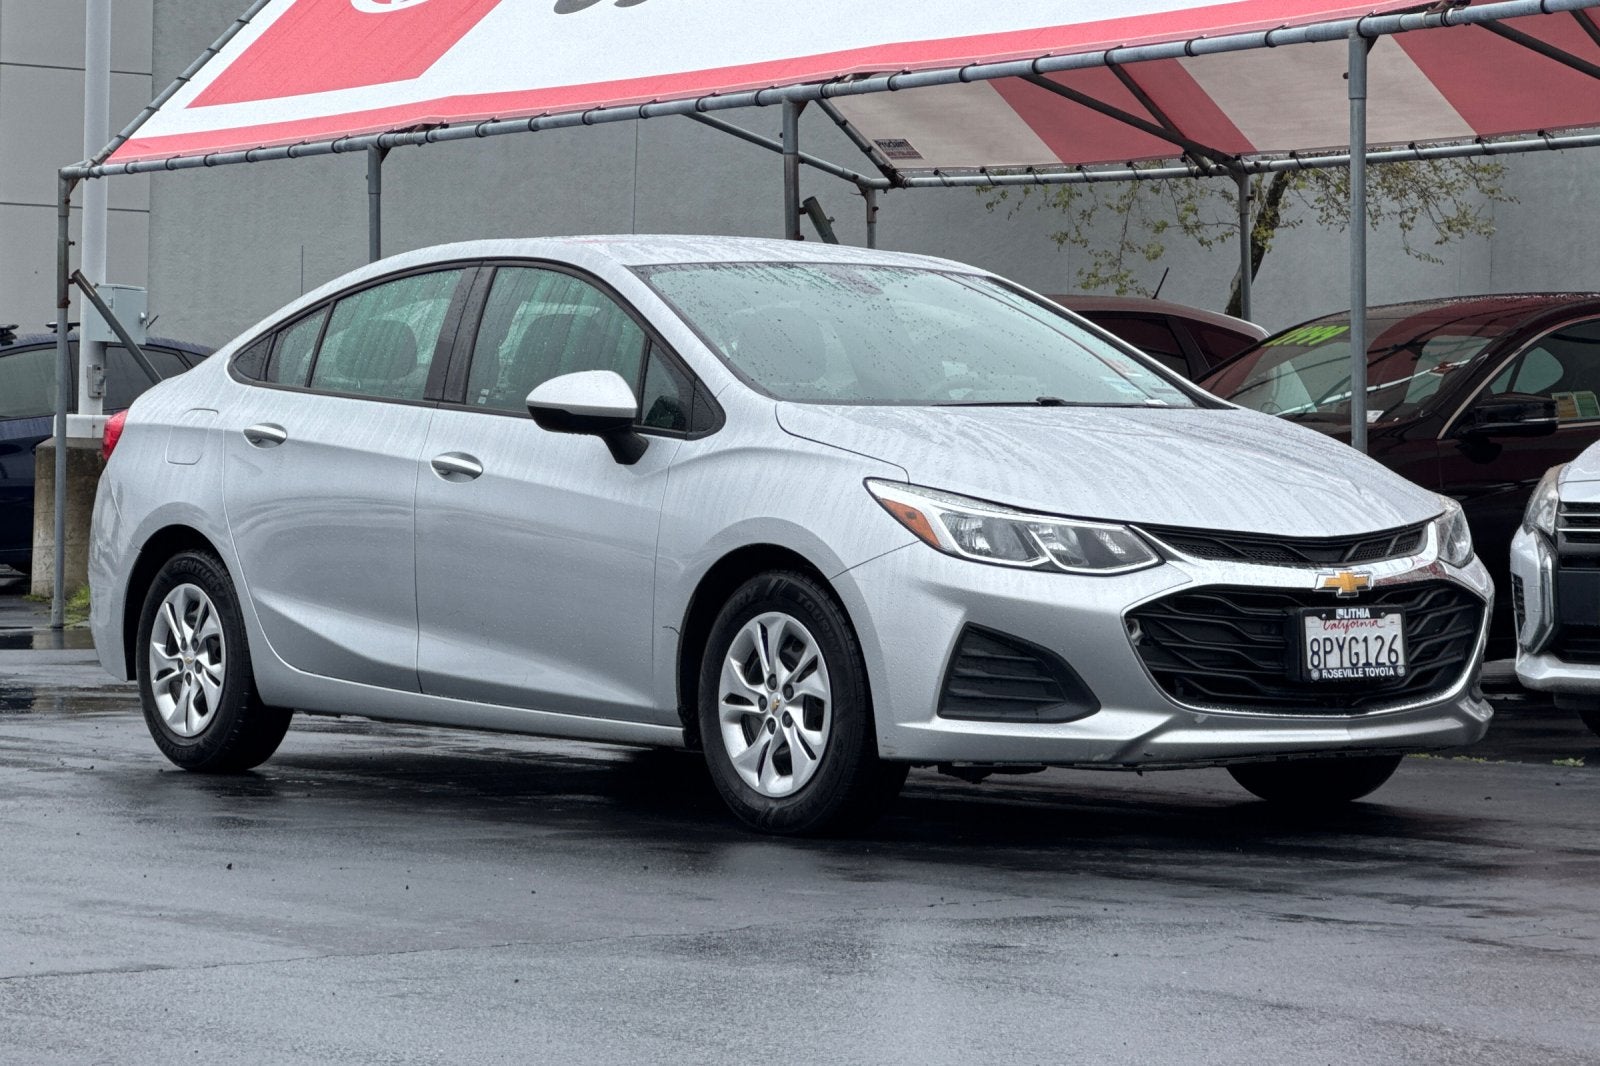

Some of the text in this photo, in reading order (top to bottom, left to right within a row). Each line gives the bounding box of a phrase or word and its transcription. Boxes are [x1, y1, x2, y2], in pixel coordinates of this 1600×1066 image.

[1344, 608, 1371, 619] LITHIA
[1323, 619, 1385, 634] California
[1310, 634, 1399, 669] 8PYG126
[1322, 667, 1395, 679] ROSEVILLE TOYOTA
